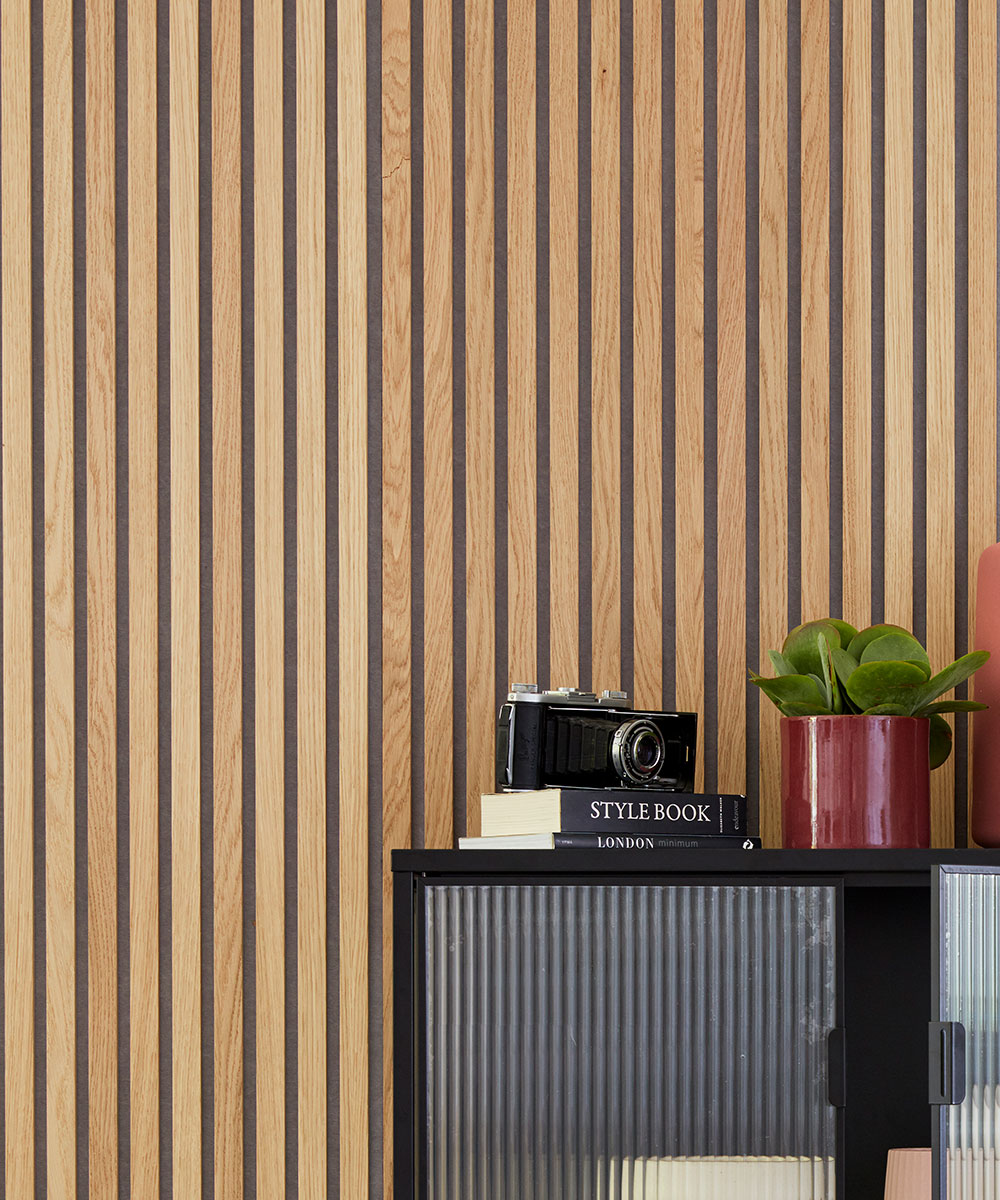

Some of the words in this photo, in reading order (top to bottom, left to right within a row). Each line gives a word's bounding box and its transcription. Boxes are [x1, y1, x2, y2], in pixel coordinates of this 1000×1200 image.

[591, 801, 650, 820] STYLE
[654, 803, 711, 822] BOOK
[597, 837, 654, 849] LONDON
[658, 839, 699, 848] minimum
